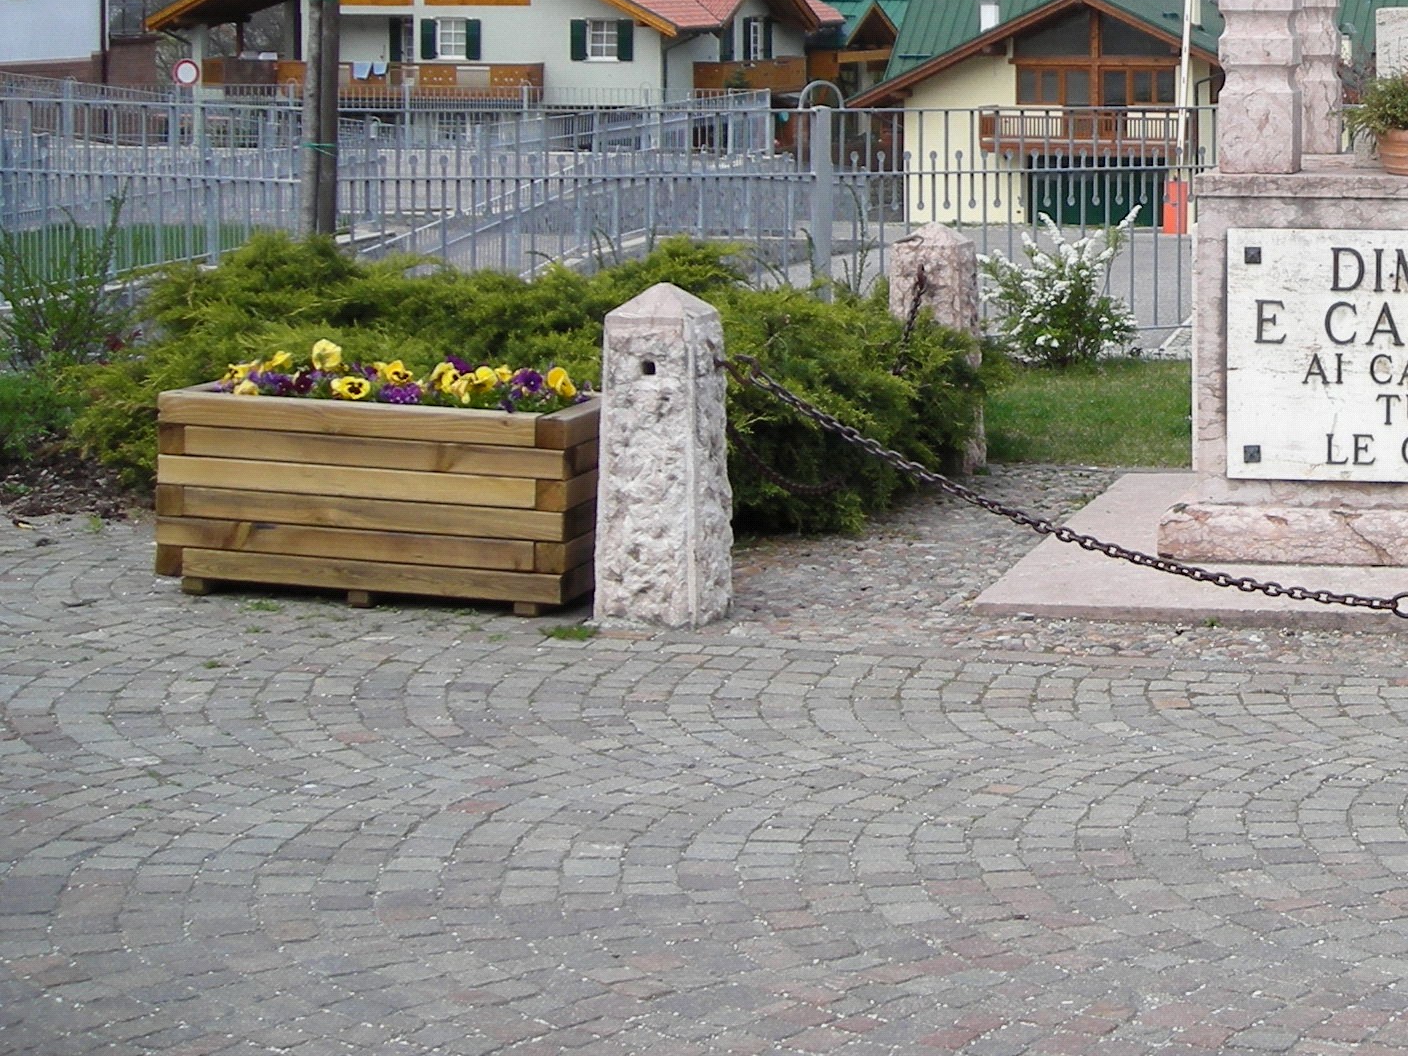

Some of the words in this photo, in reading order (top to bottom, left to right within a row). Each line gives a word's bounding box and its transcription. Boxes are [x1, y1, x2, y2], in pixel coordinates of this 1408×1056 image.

[1255, 299, 1287, 344] E
[1302, 353, 1343, 385] AI
[1326, 433, 1375, 465] LE
